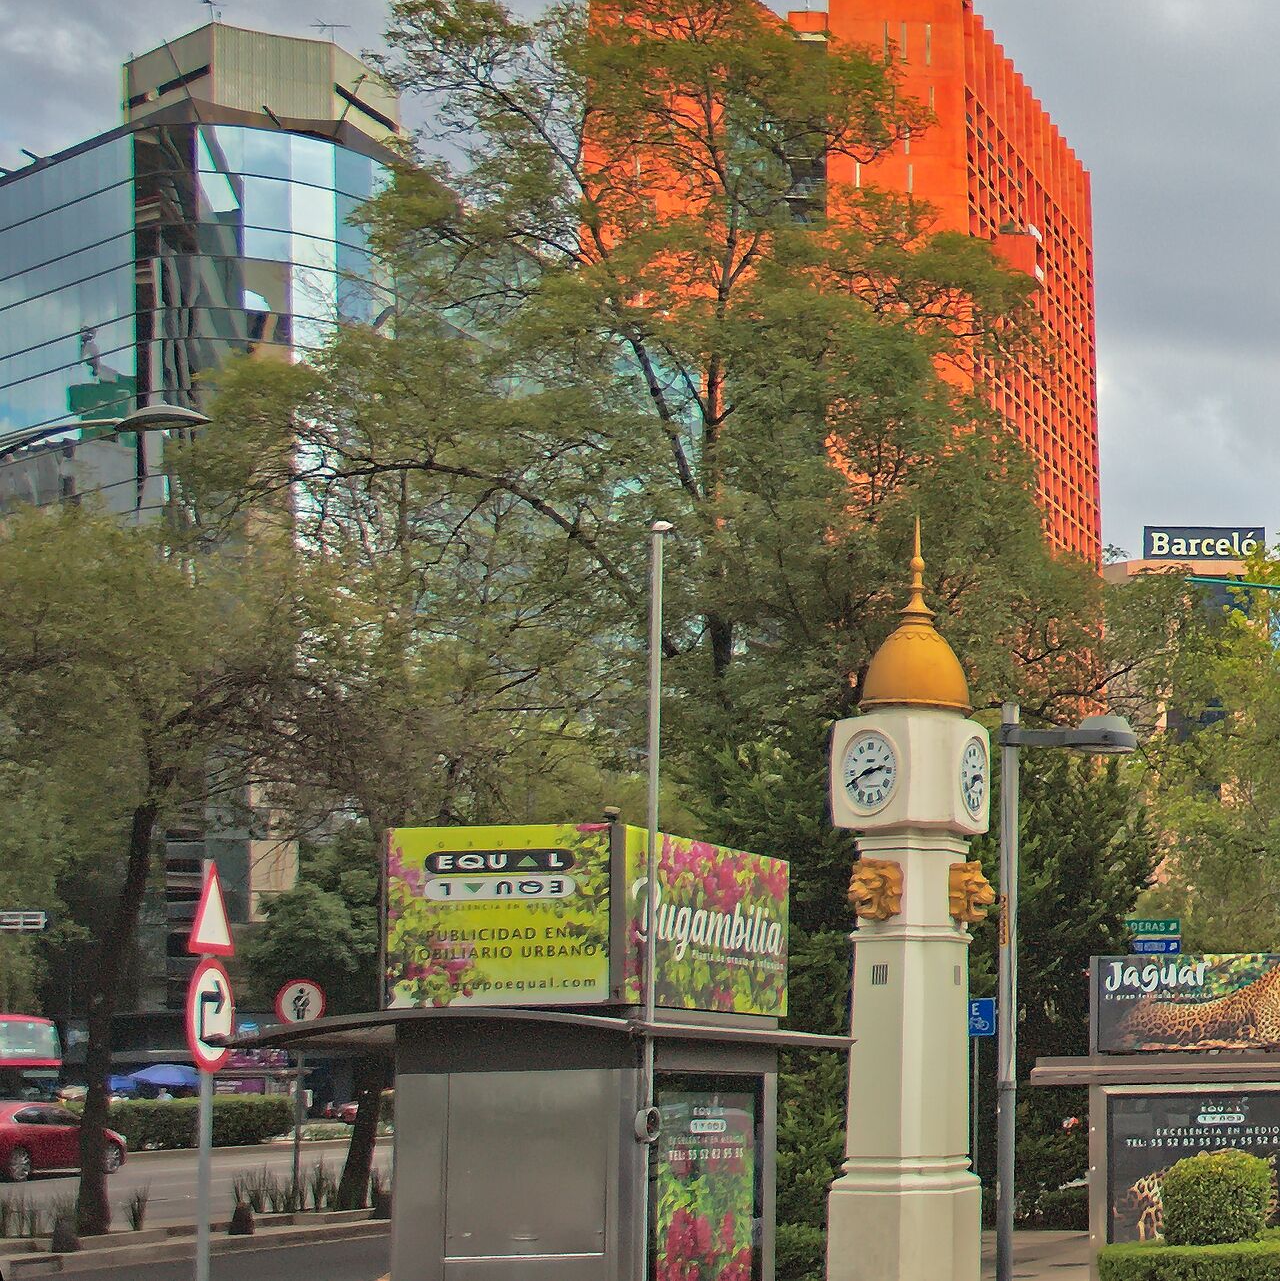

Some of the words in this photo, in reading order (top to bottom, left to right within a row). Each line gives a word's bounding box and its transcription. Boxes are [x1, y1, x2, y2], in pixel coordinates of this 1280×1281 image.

[1150, 531, 1258, 557] Barceló
[632, 876, 785, 962] Bugambilia
[1125, 921, 1166, 932] DERAS
[425, 926, 537, 943] PUBLICIDAD
[544, 926, 567, 940] EN
[520, 943, 598, 958] URBANO
[1105, 961, 1212, 992] Jaguar
[1156, 1127, 1222, 1136] EXCELENCIA
[1227, 1126, 1241, 1135] EN
